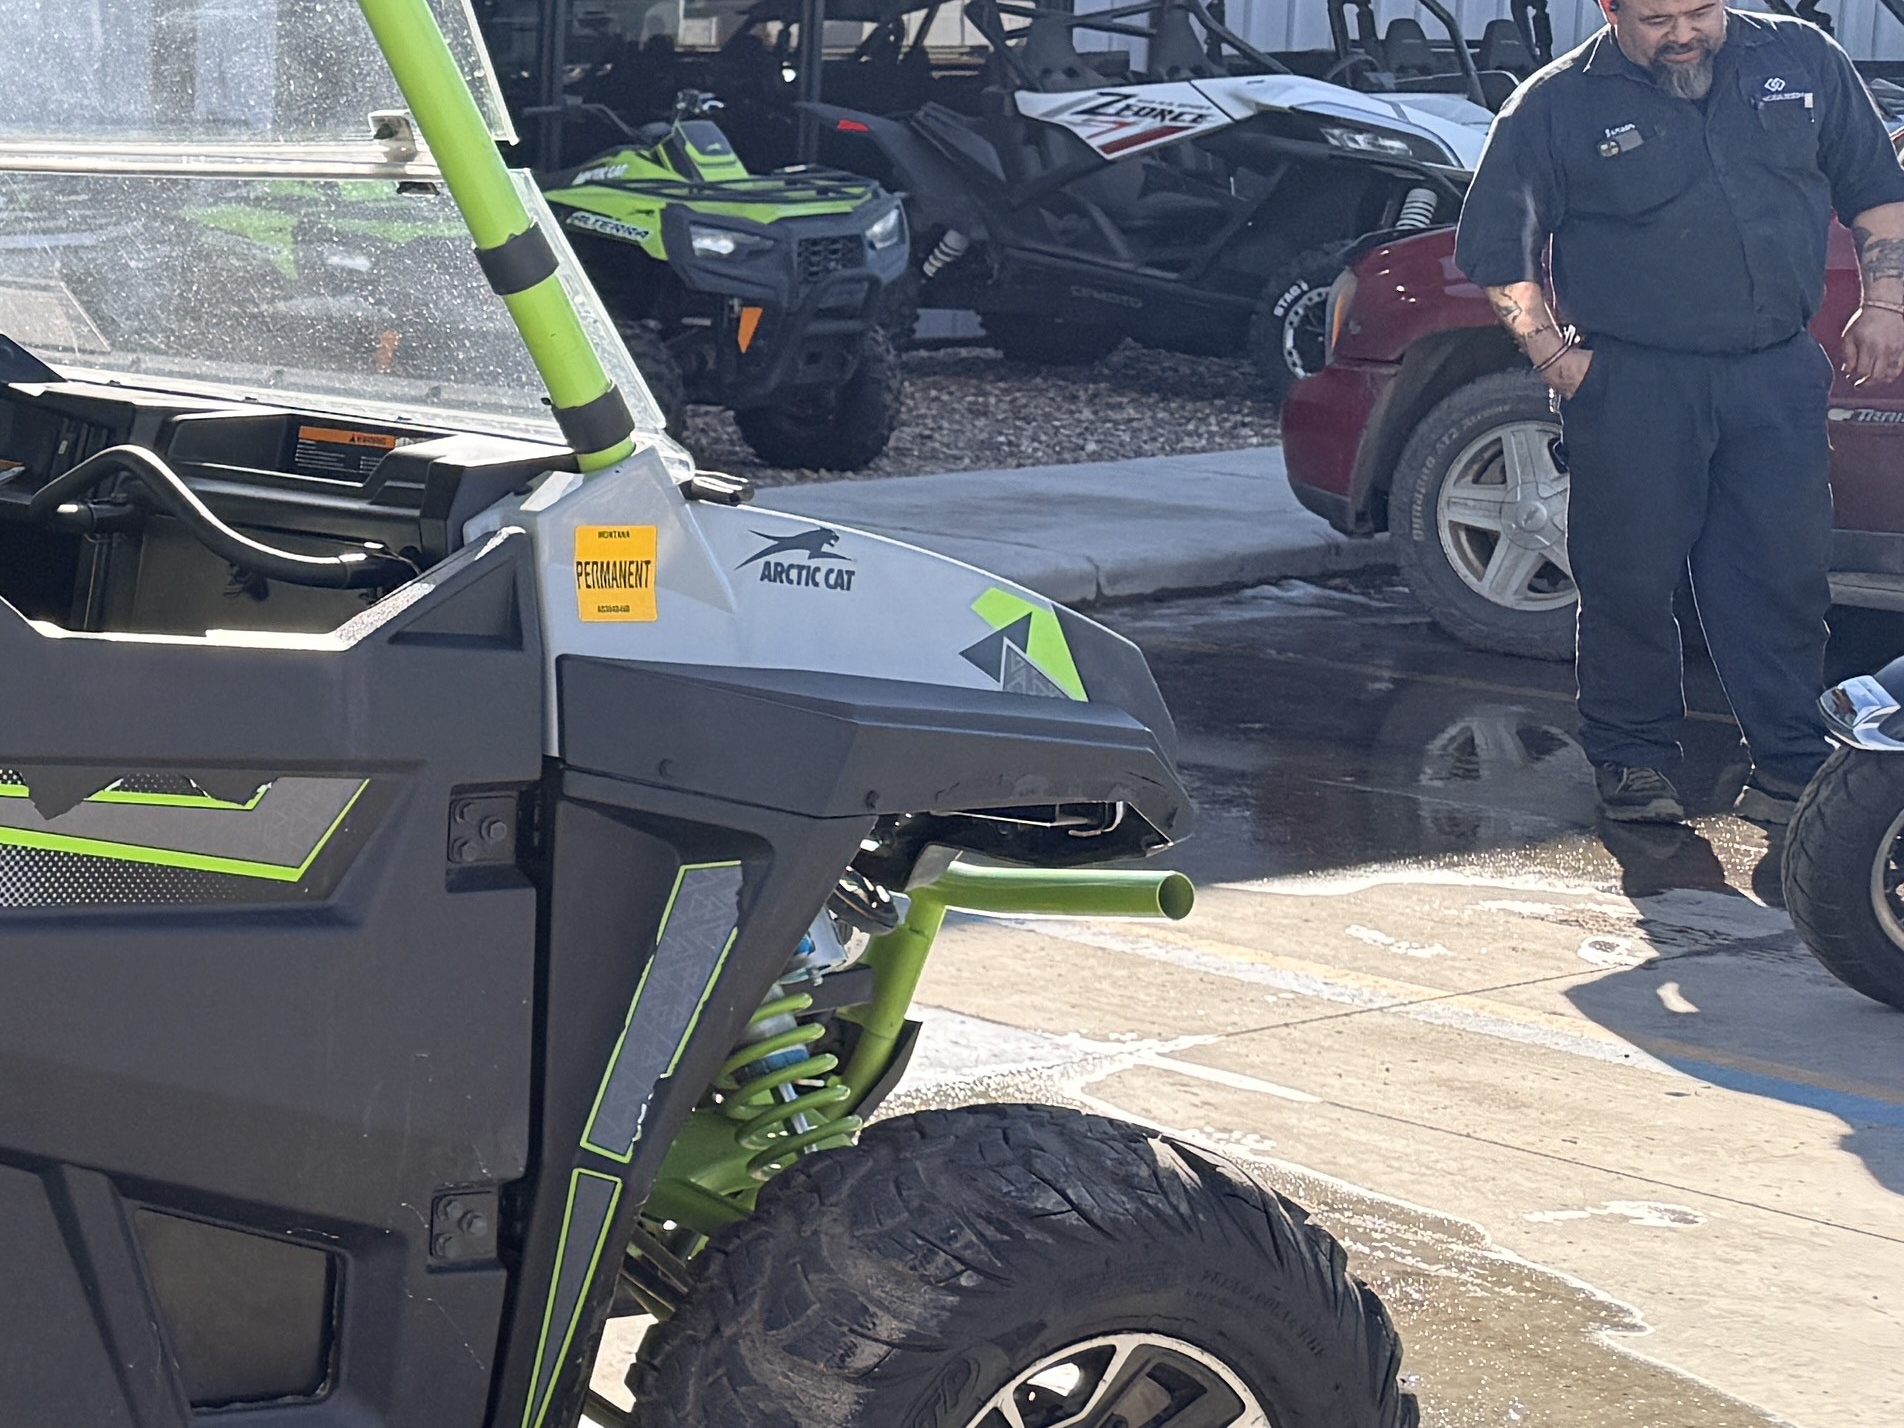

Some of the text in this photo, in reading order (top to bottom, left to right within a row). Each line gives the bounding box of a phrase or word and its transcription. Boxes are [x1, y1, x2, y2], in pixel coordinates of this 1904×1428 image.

[571, 214, 649, 239] ALTERRA
[576, 560, 651, 589] PERMANENT
[759, 561, 855, 591] ARCTIC CAT
